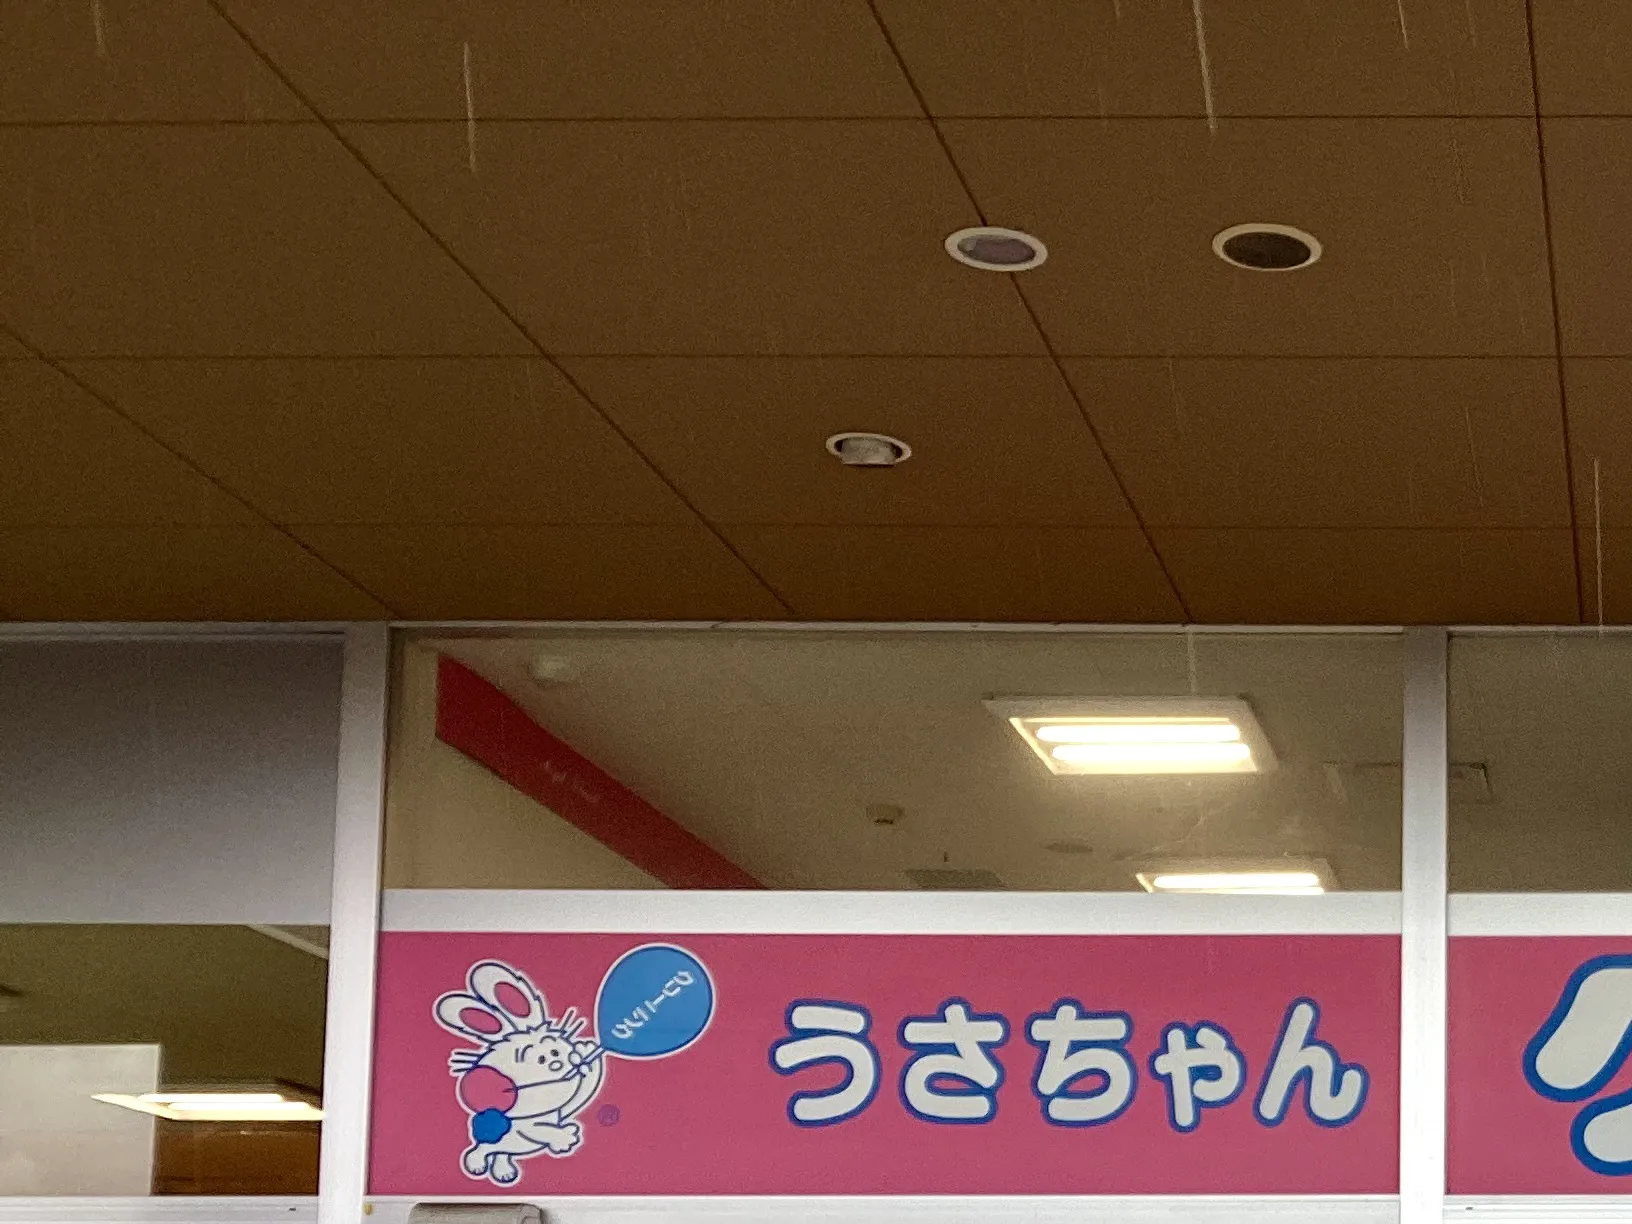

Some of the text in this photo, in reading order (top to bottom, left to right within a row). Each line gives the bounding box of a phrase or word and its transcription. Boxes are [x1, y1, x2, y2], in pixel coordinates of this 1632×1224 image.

[769, 997, 1370, 1132] うさちゃん
